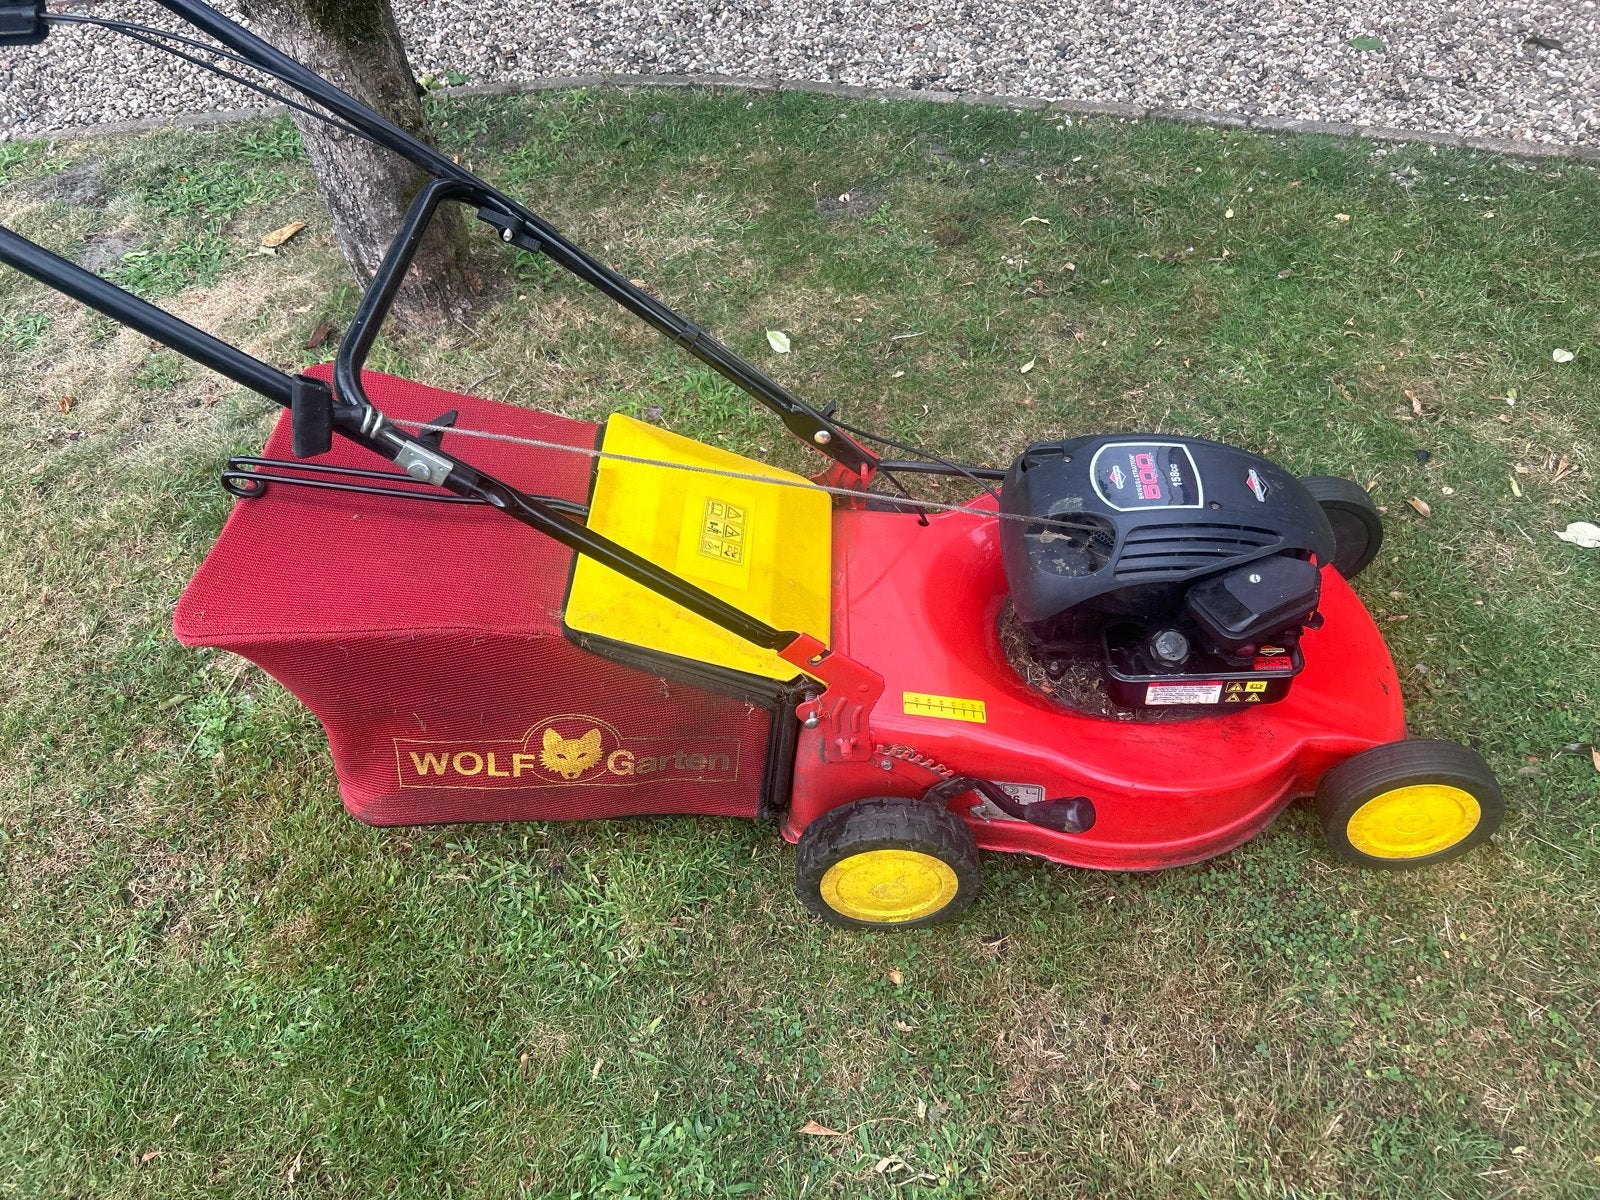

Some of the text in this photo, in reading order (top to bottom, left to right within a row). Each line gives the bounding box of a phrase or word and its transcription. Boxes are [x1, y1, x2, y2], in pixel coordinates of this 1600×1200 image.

[1136, 454, 1161, 499] 500
[1170, 463, 1182, 487] 158cc
[409, 749, 730, 777] WOLF Garten
